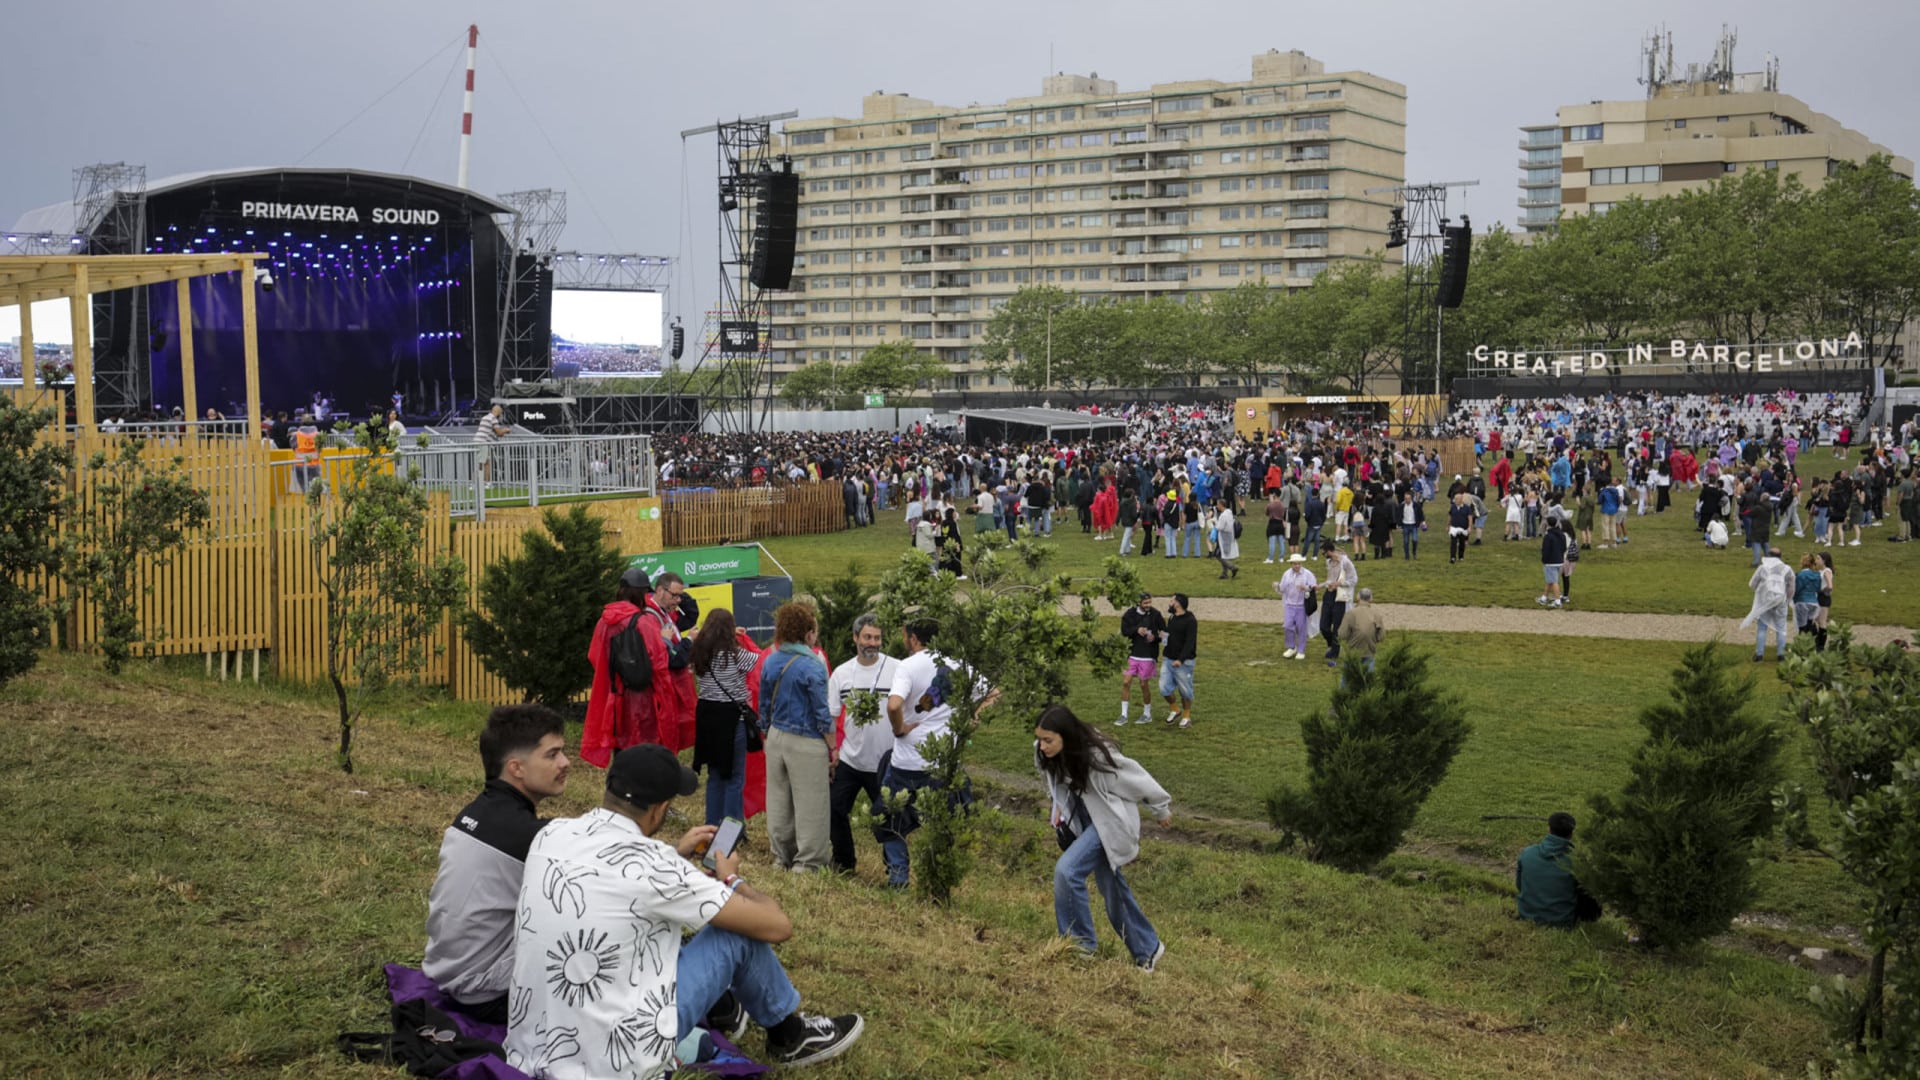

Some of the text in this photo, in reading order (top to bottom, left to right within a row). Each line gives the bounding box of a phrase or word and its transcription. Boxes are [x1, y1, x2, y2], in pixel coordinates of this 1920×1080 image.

[242, 201, 440, 225] PRIMAVERA SOUND
[1474, 331, 1862, 378] CREATED IN BARCELONA
[699, 559, 739, 571] novoverde
